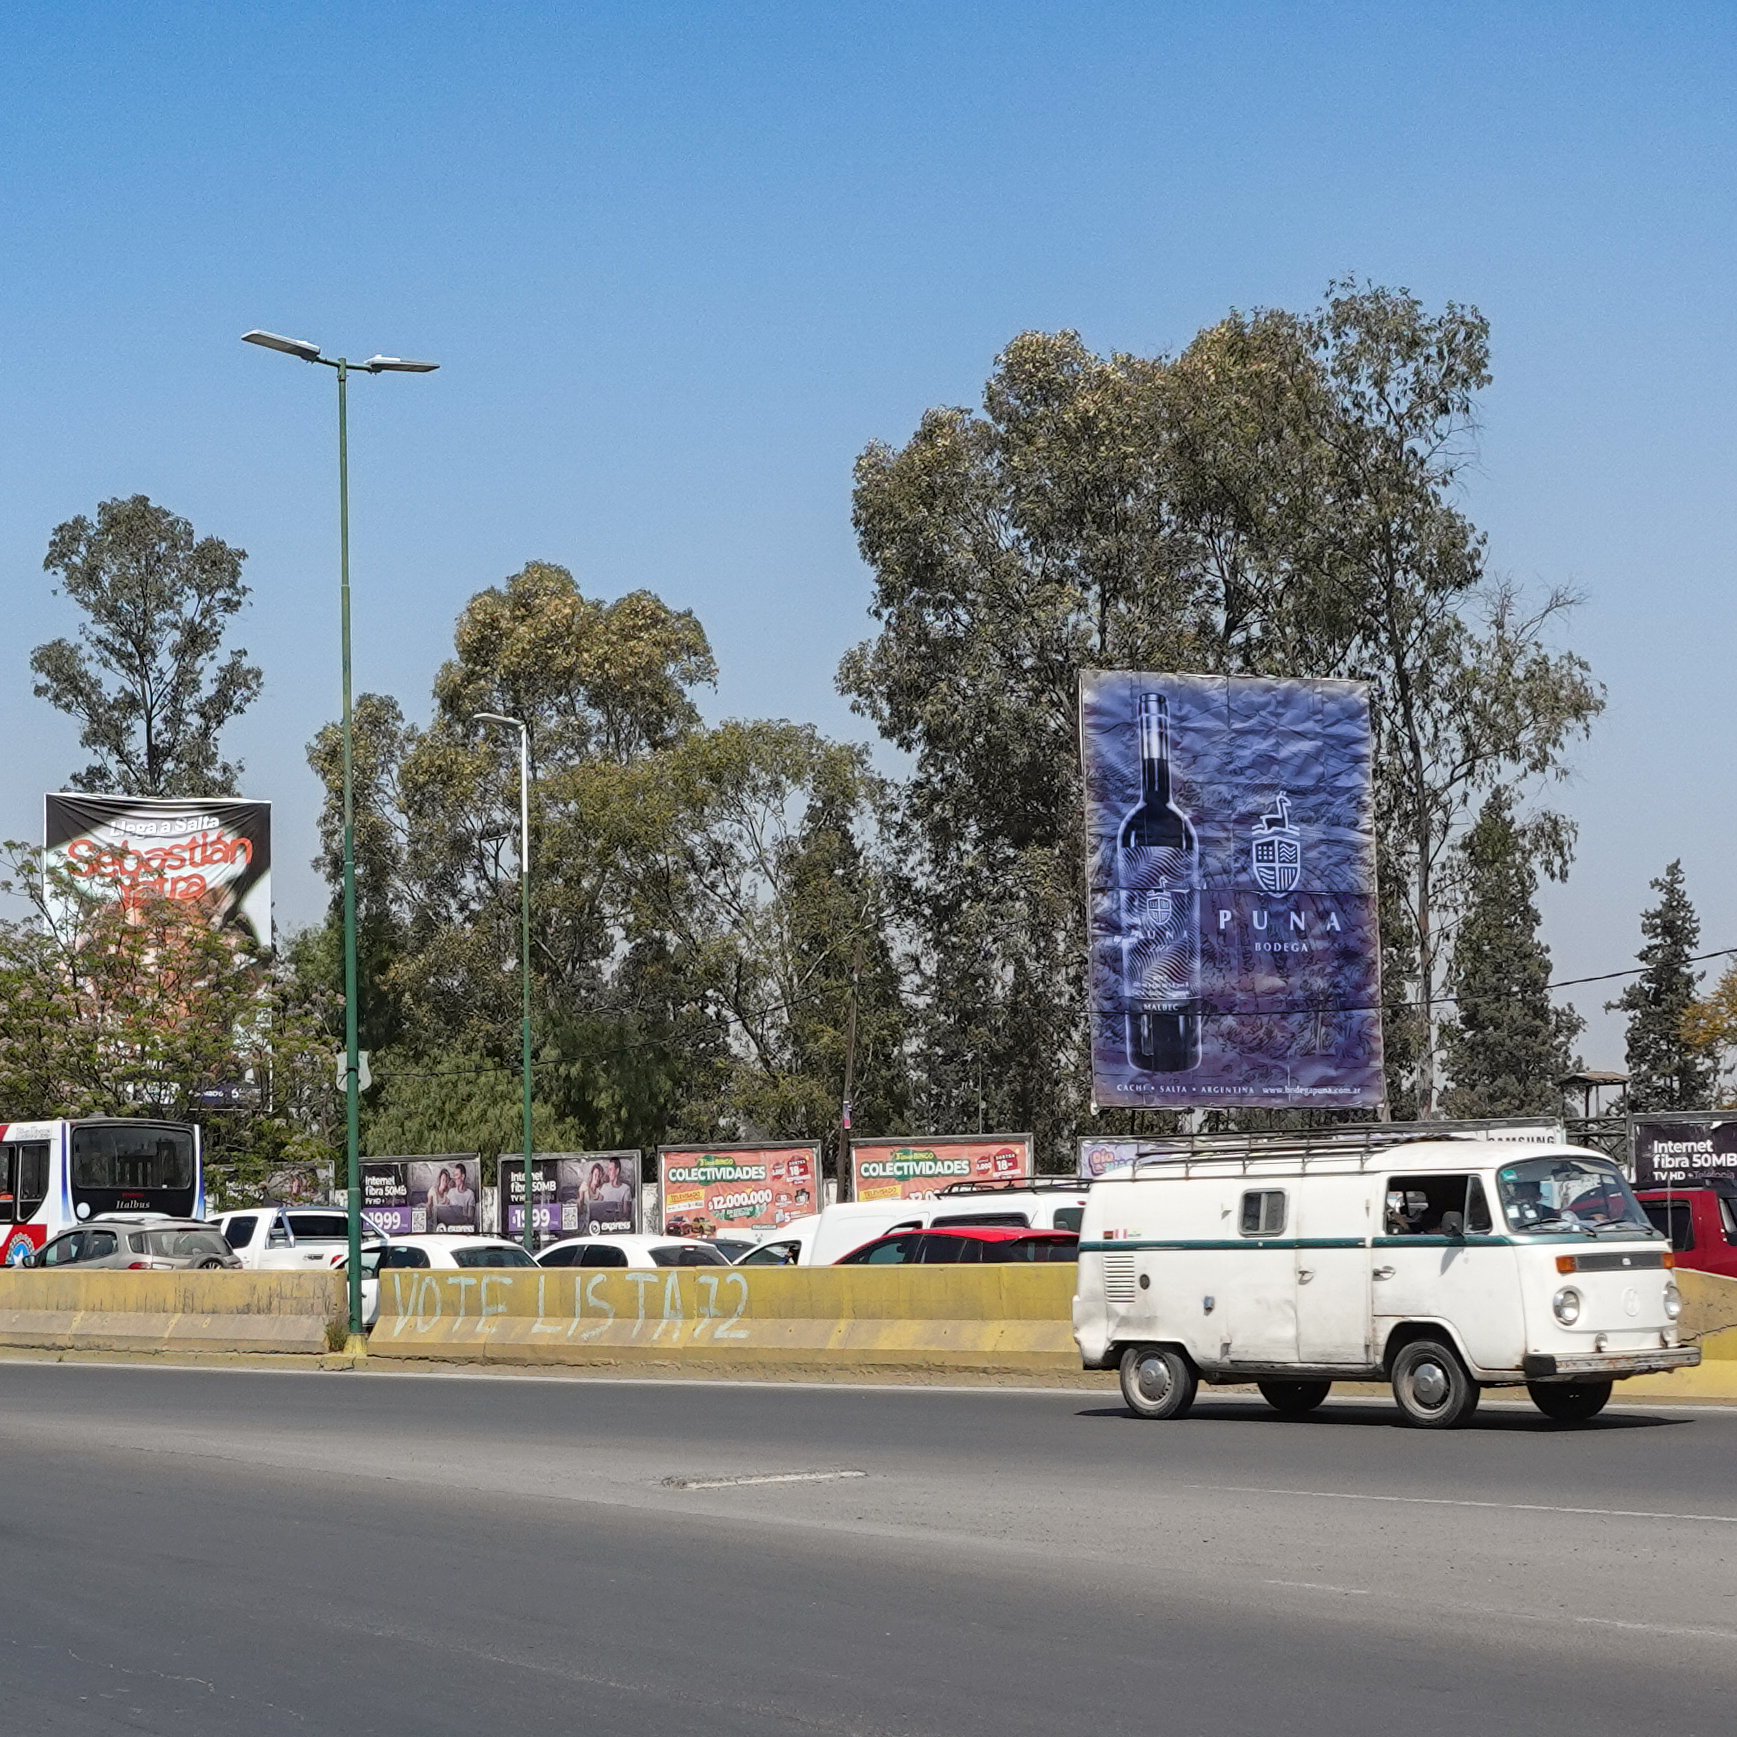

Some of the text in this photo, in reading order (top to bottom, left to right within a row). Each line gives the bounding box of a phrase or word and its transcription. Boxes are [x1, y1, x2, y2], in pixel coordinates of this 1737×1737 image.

[161, 822, 172, 834] a
[175, 816, 220, 832] Salta
[1219, 909, 1342, 931] PUNA
[1254, 942, 1308, 952] BODEGA
[1143, 1003, 1179, 1012] MALBEC
[1116, 1083, 1148, 1092] CACHI
[1159, 1085, 1188, 1094] SALTA
[1201, 1086, 1255, 1095] ARGENTINA
[1653, 1140, 1714, 1154] Internet
[996, 1160, 1008, 1171] 18
[1653, 1152, 1737, 1168] fibra 50MB
[668, 1166, 766, 1182] COLECTIVIDADES
[860, 1160, 970, 1177] COLECTIVIDADES
[365, 1175, 395, 1185] Internet
[1653, 1171, 1668, 1181] TV
[1669, 1171, 1686, 1181] HD
[365, 1185, 408, 1196] fibra 50MB
[531, 1180, 557, 1192] 50MB
[116, 1200, 151, 1209] Italbus
[394, 1271, 750, 1341] VOTE LISTA 72
